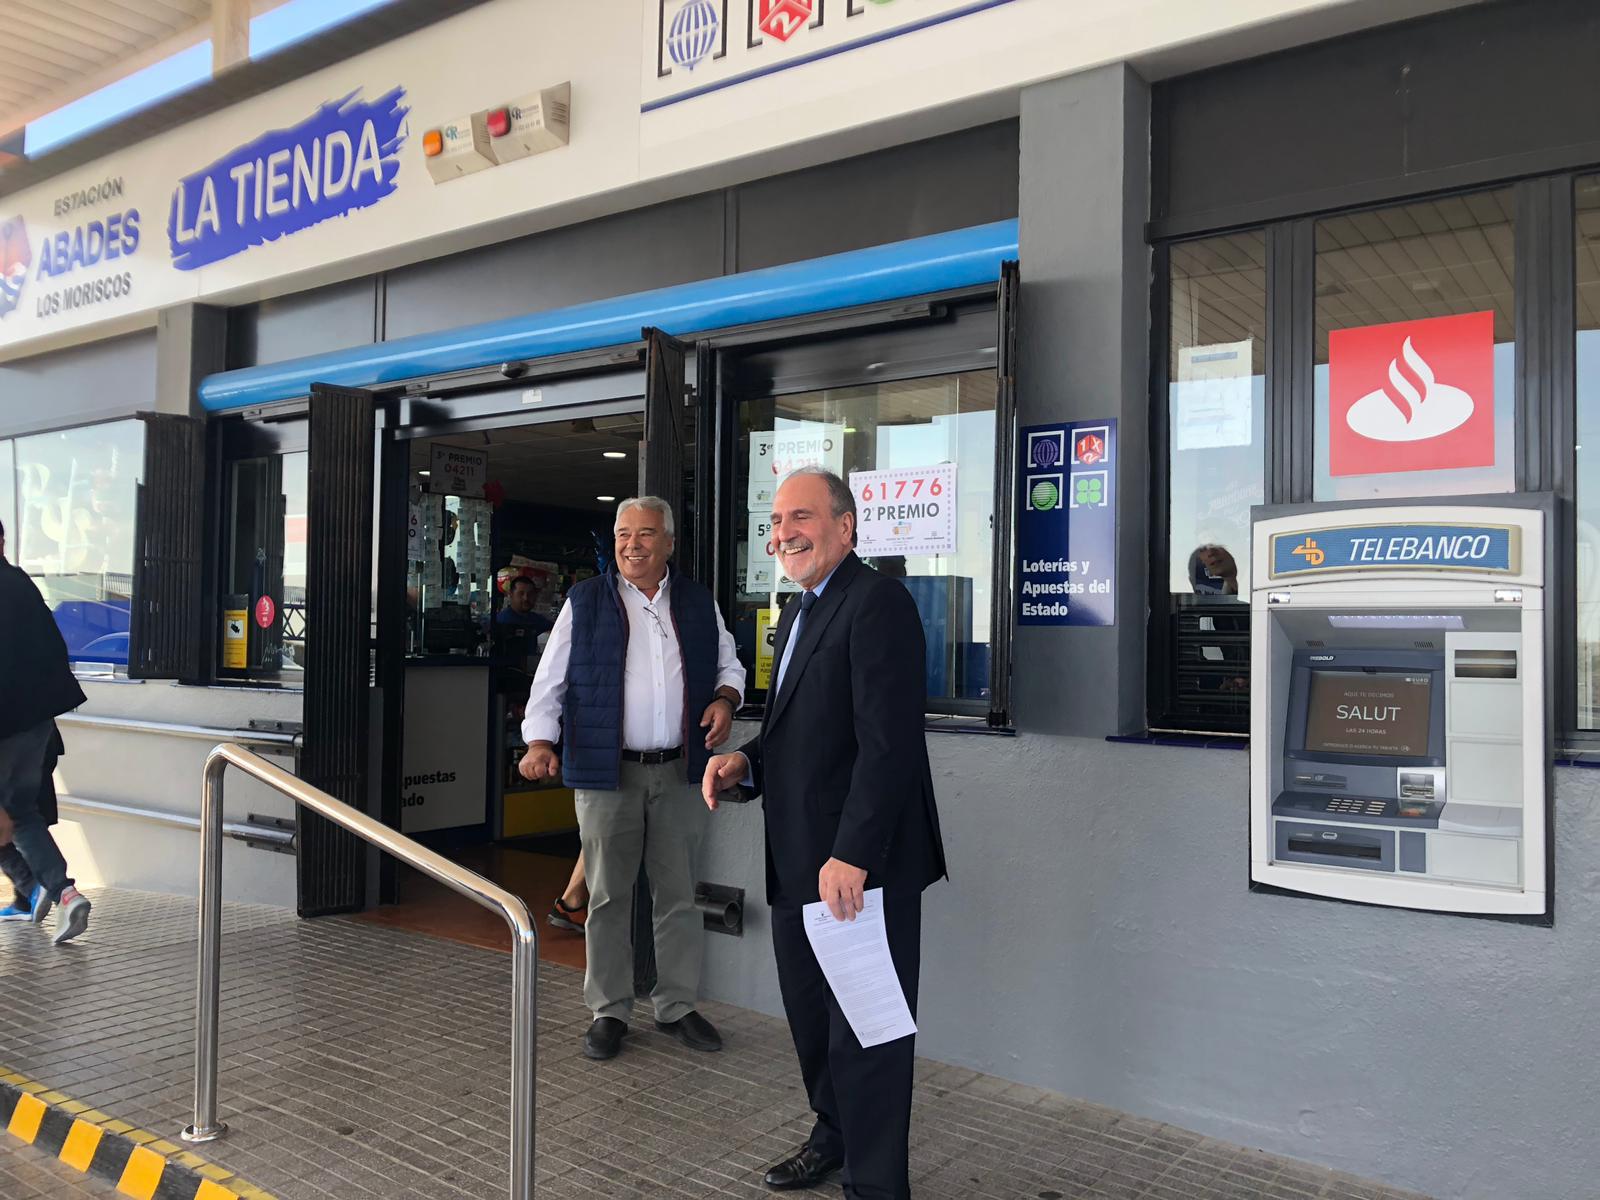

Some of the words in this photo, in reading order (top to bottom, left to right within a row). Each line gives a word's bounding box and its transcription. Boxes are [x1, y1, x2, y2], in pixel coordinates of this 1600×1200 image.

[176, 175, 220, 244] LA
[229, 119, 383, 227] TIENDA
[54, 176, 124, 217] ESTACIÓN
[36, 208, 140, 281] ABADES
[36, 291, 60, 318] LOS
[62, 271, 132, 311] MORISCOS
[777, 439, 834, 455] PREMIO
[448, 452, 483, 466] PREMIO
[444, 463, 475, 477] 04211
[862, 478, 943, 502] 61776
[877, 502, 940, 520] PREMIO
[1349, 534, 1491, 562] TELEBANCO
[1022, 557, 1078, 573] Loterías
[1081, 559, 1090, 575] y
[1022, 580, 1085, 597] Apuestas
[1088, 579, 1111, 594] del
[1022, 603, 1069, 617] Estado
[1336, 704, 1401, 721] SALUT
[404, 770, 457, 790] puestas
